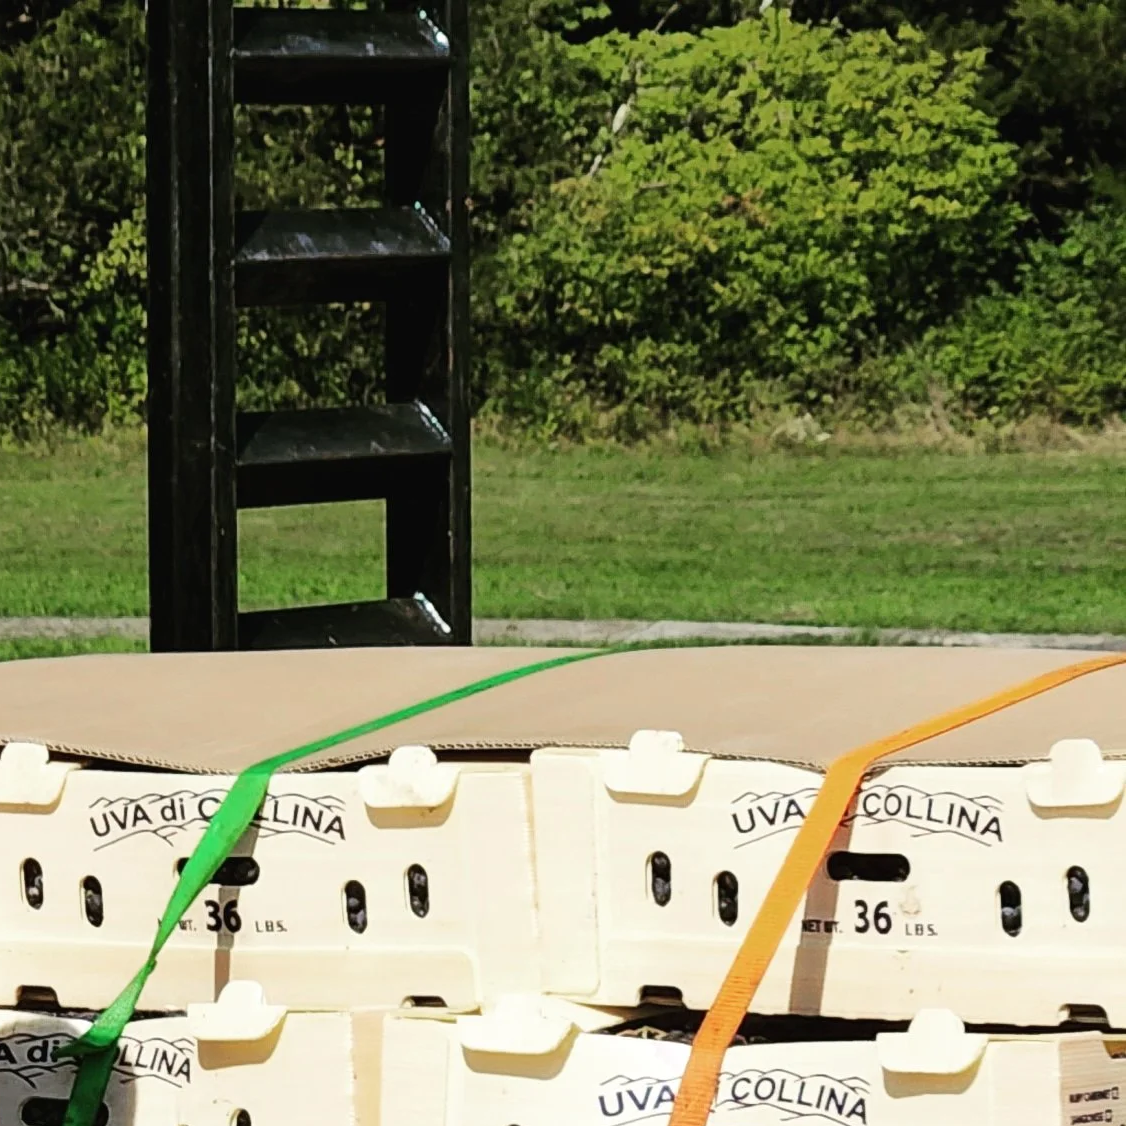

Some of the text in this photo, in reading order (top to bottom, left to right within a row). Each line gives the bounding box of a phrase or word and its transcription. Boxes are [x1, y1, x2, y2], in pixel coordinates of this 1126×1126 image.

[90, 803, 153, 837] UVA
[160, 797, 187, 822] di
[732, 798, 806, 834] UVA
[862, 792, 1003, 842] COLLINA
[204, 899, 242, 933] 36
[255, 919, 288, 933] LBS.
[854, 899, 892, 934] 36
[905, 923, 938, 936] LBS.
[598, 1084, 676, 1117] UVA
[731, 1076, 868, 1126] COLLINA
